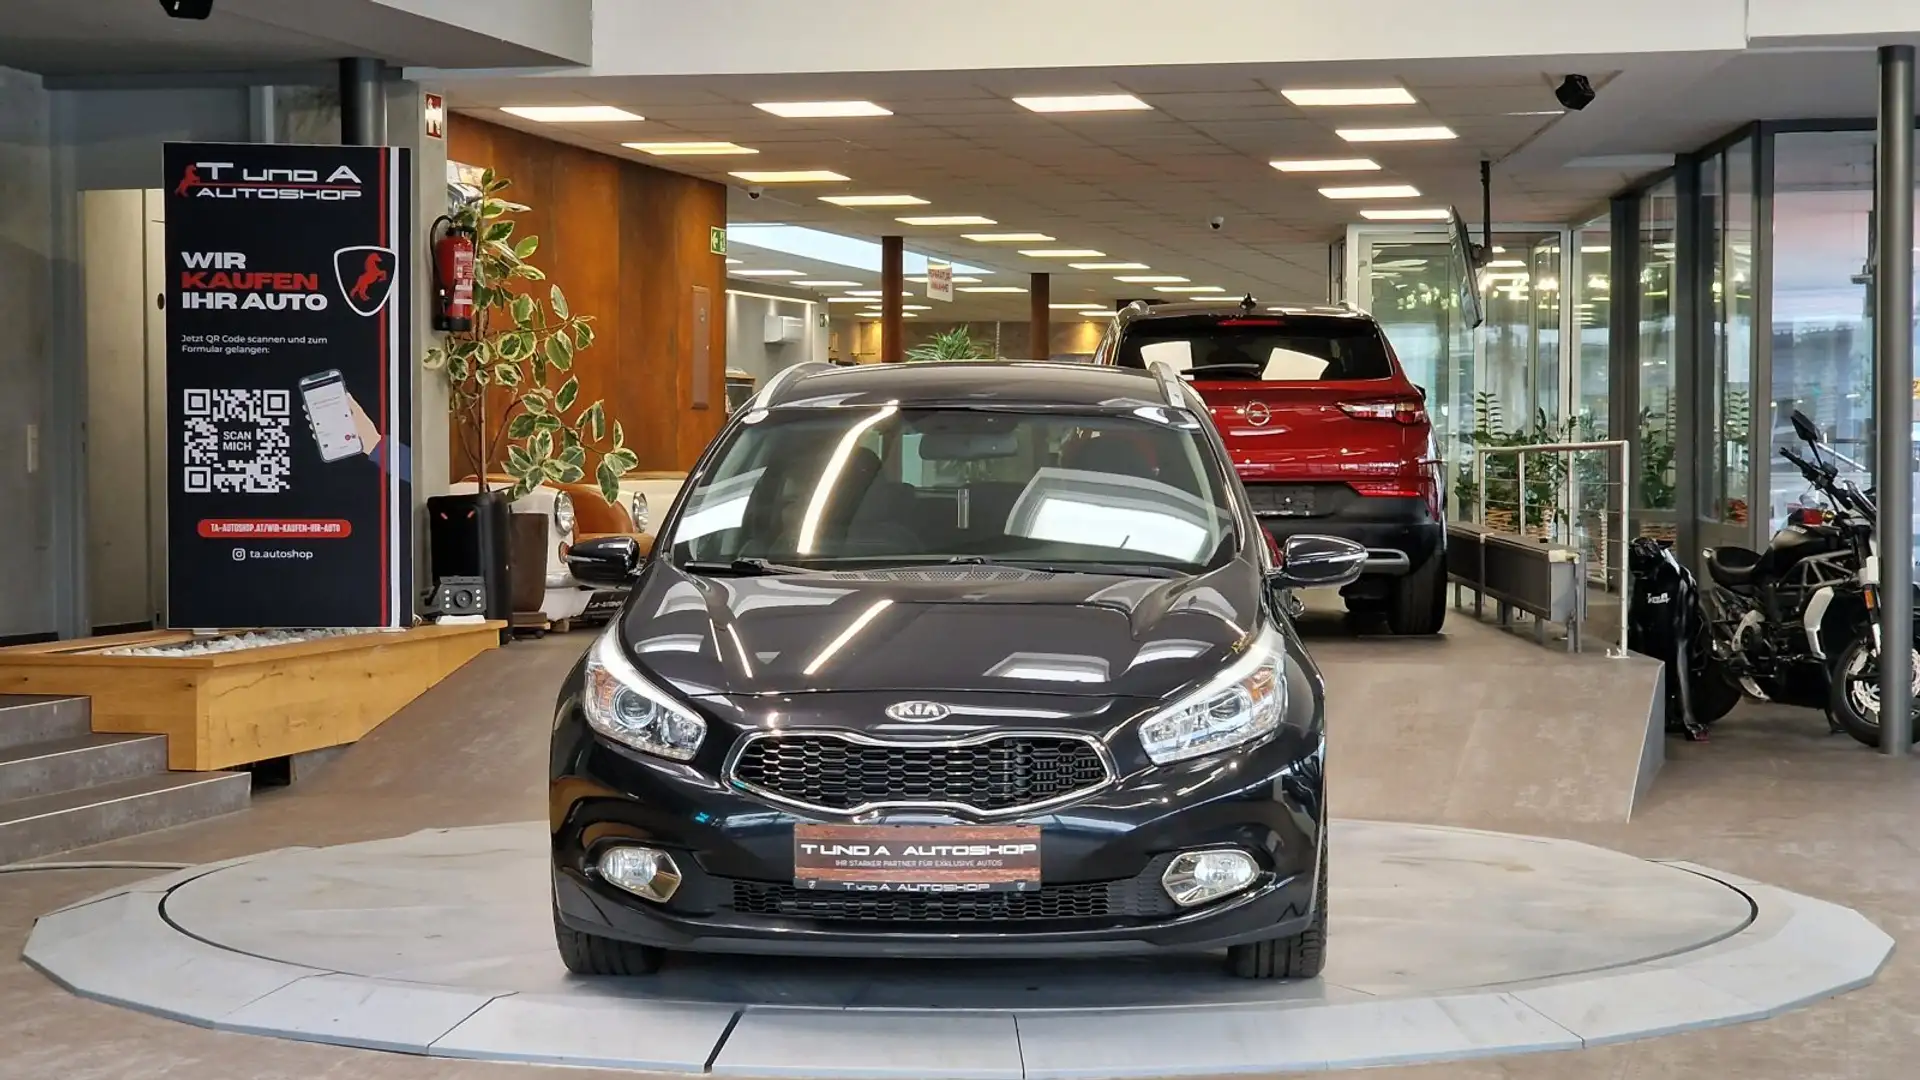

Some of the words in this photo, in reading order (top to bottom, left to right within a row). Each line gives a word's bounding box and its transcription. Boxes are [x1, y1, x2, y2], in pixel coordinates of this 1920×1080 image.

[196, 187, 362, 200] AUTOSHOP
[181, 251, 247, 269] WIR
[181, 272, 319, 290] KAUFEN
[182, 292, 238, 310] IHR
[241, 293, 328, 311] AUTO
[181, 334, 204, 342] Jetzt
[205, 334, 220, 344] QR
[221, 335, 246, 343] Code
[247, 336, 286, 344] scannen
[287, 336, 306, 344] und
[181, 345, 223, 353] Formular
[224, 346, 270, 355] gelangen:
[223, 431, 252, 441] SCAN
[223, 441, 252, 452] MICH
[249, 549, 314, 560] ta.autoshop
[897, 703, 940, 717] KIA
[902, 844, 1037, 856] AUTOSHOP
[896, 883, 991, 892] AUTOSHOP
